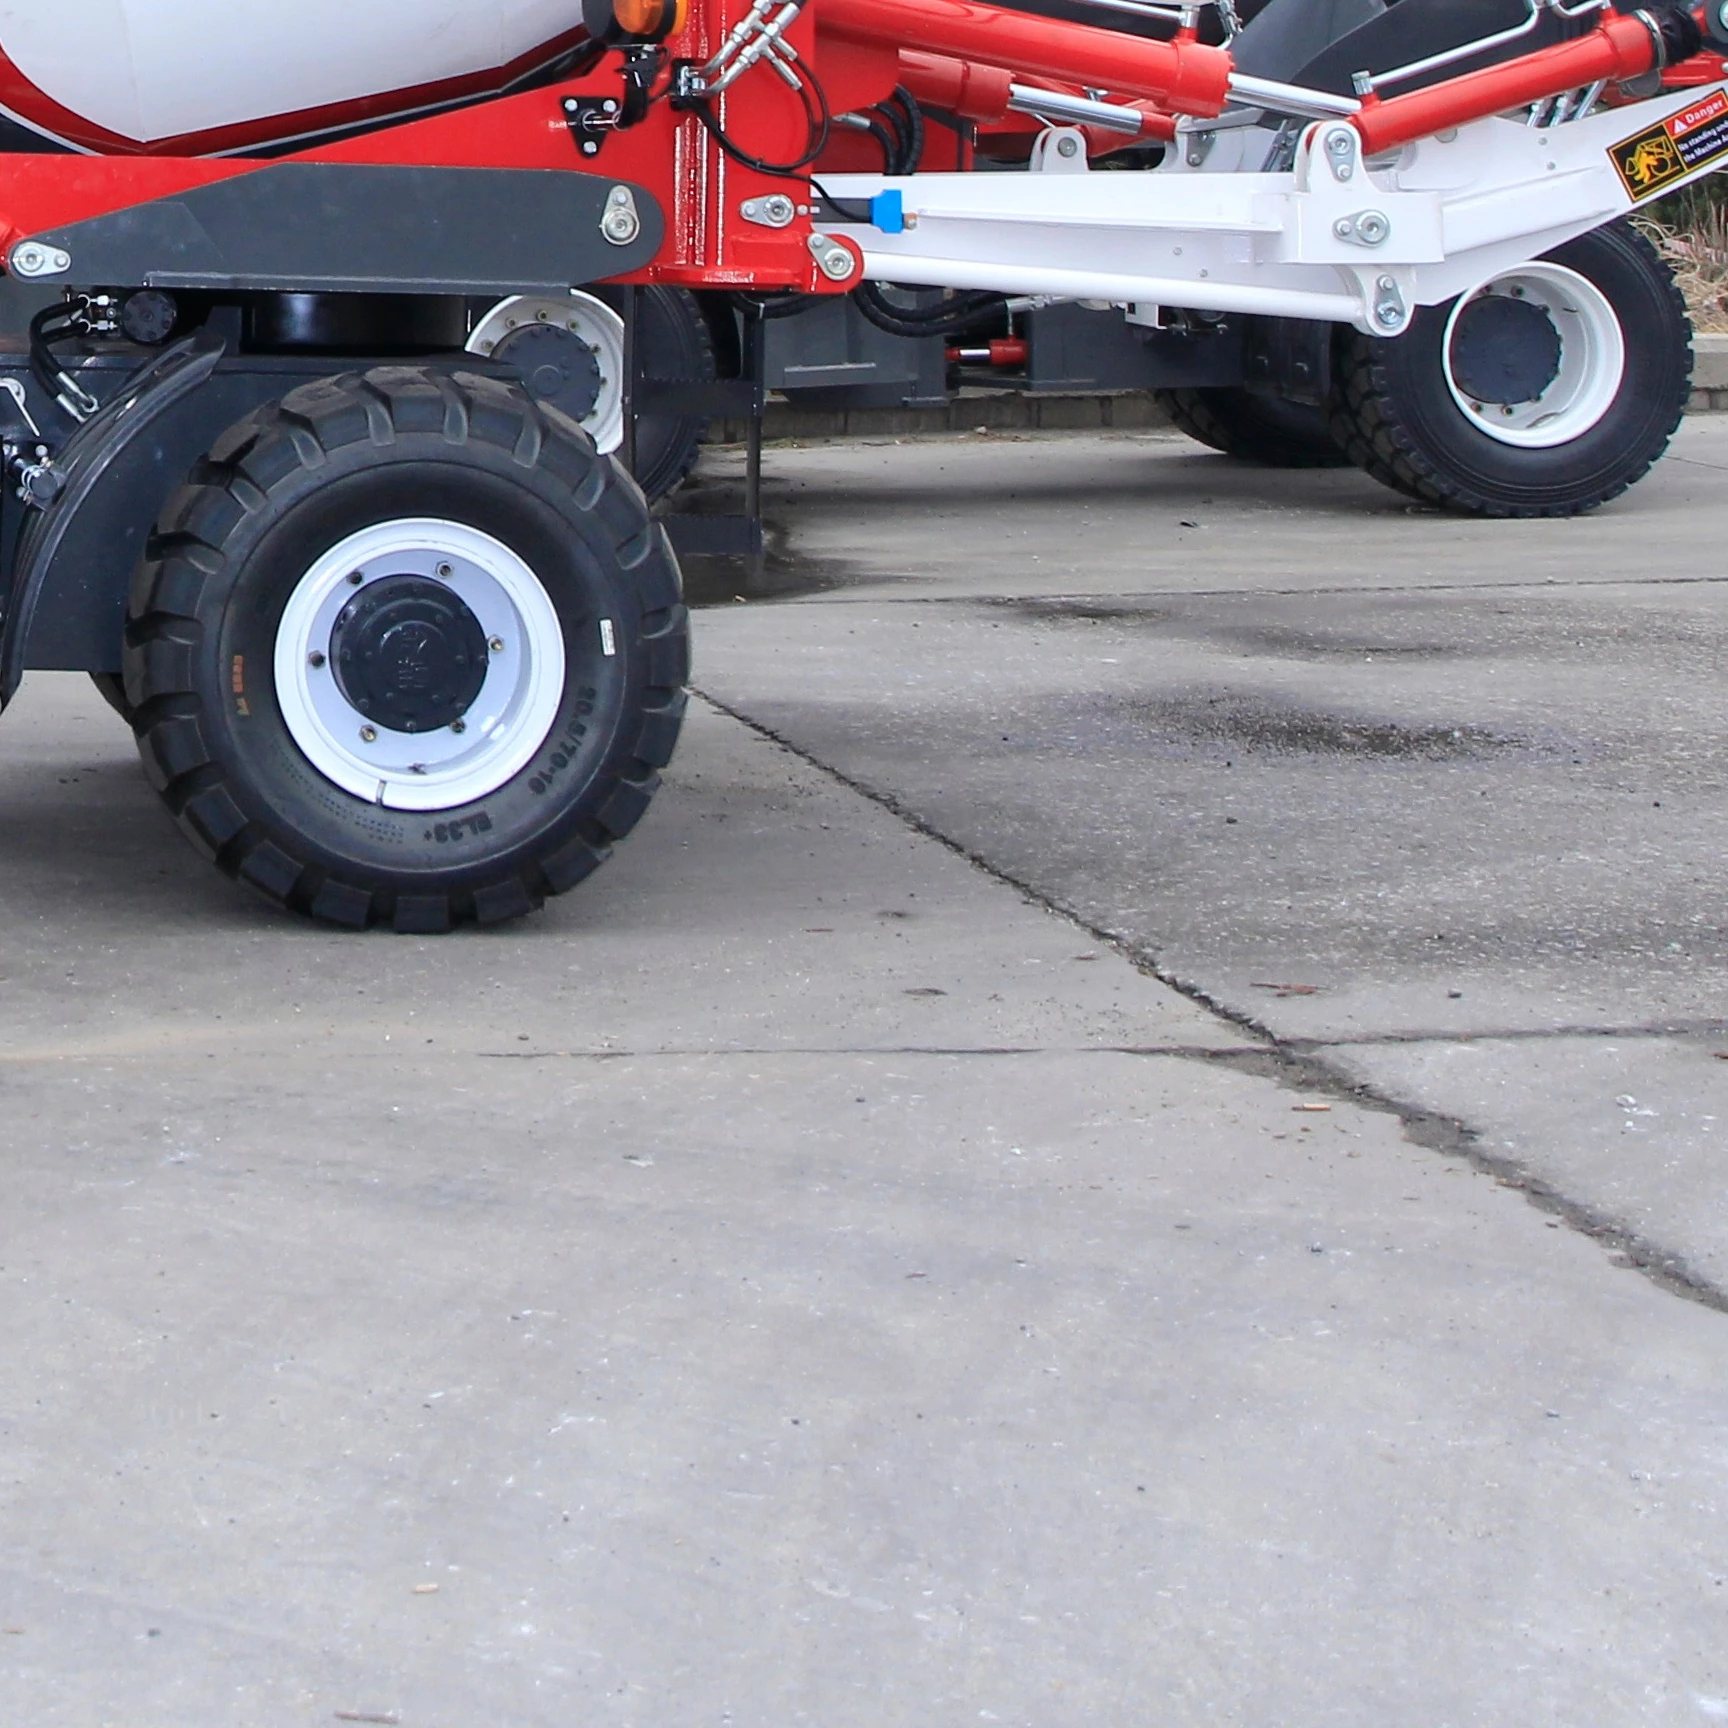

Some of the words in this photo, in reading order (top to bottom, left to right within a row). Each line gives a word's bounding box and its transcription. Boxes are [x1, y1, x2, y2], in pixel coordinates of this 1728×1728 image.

[1685, 100, 1723, 124] Danger
[1688, 128, 1717, 147] standing
[1693, 138, 1722, 157] Machine
